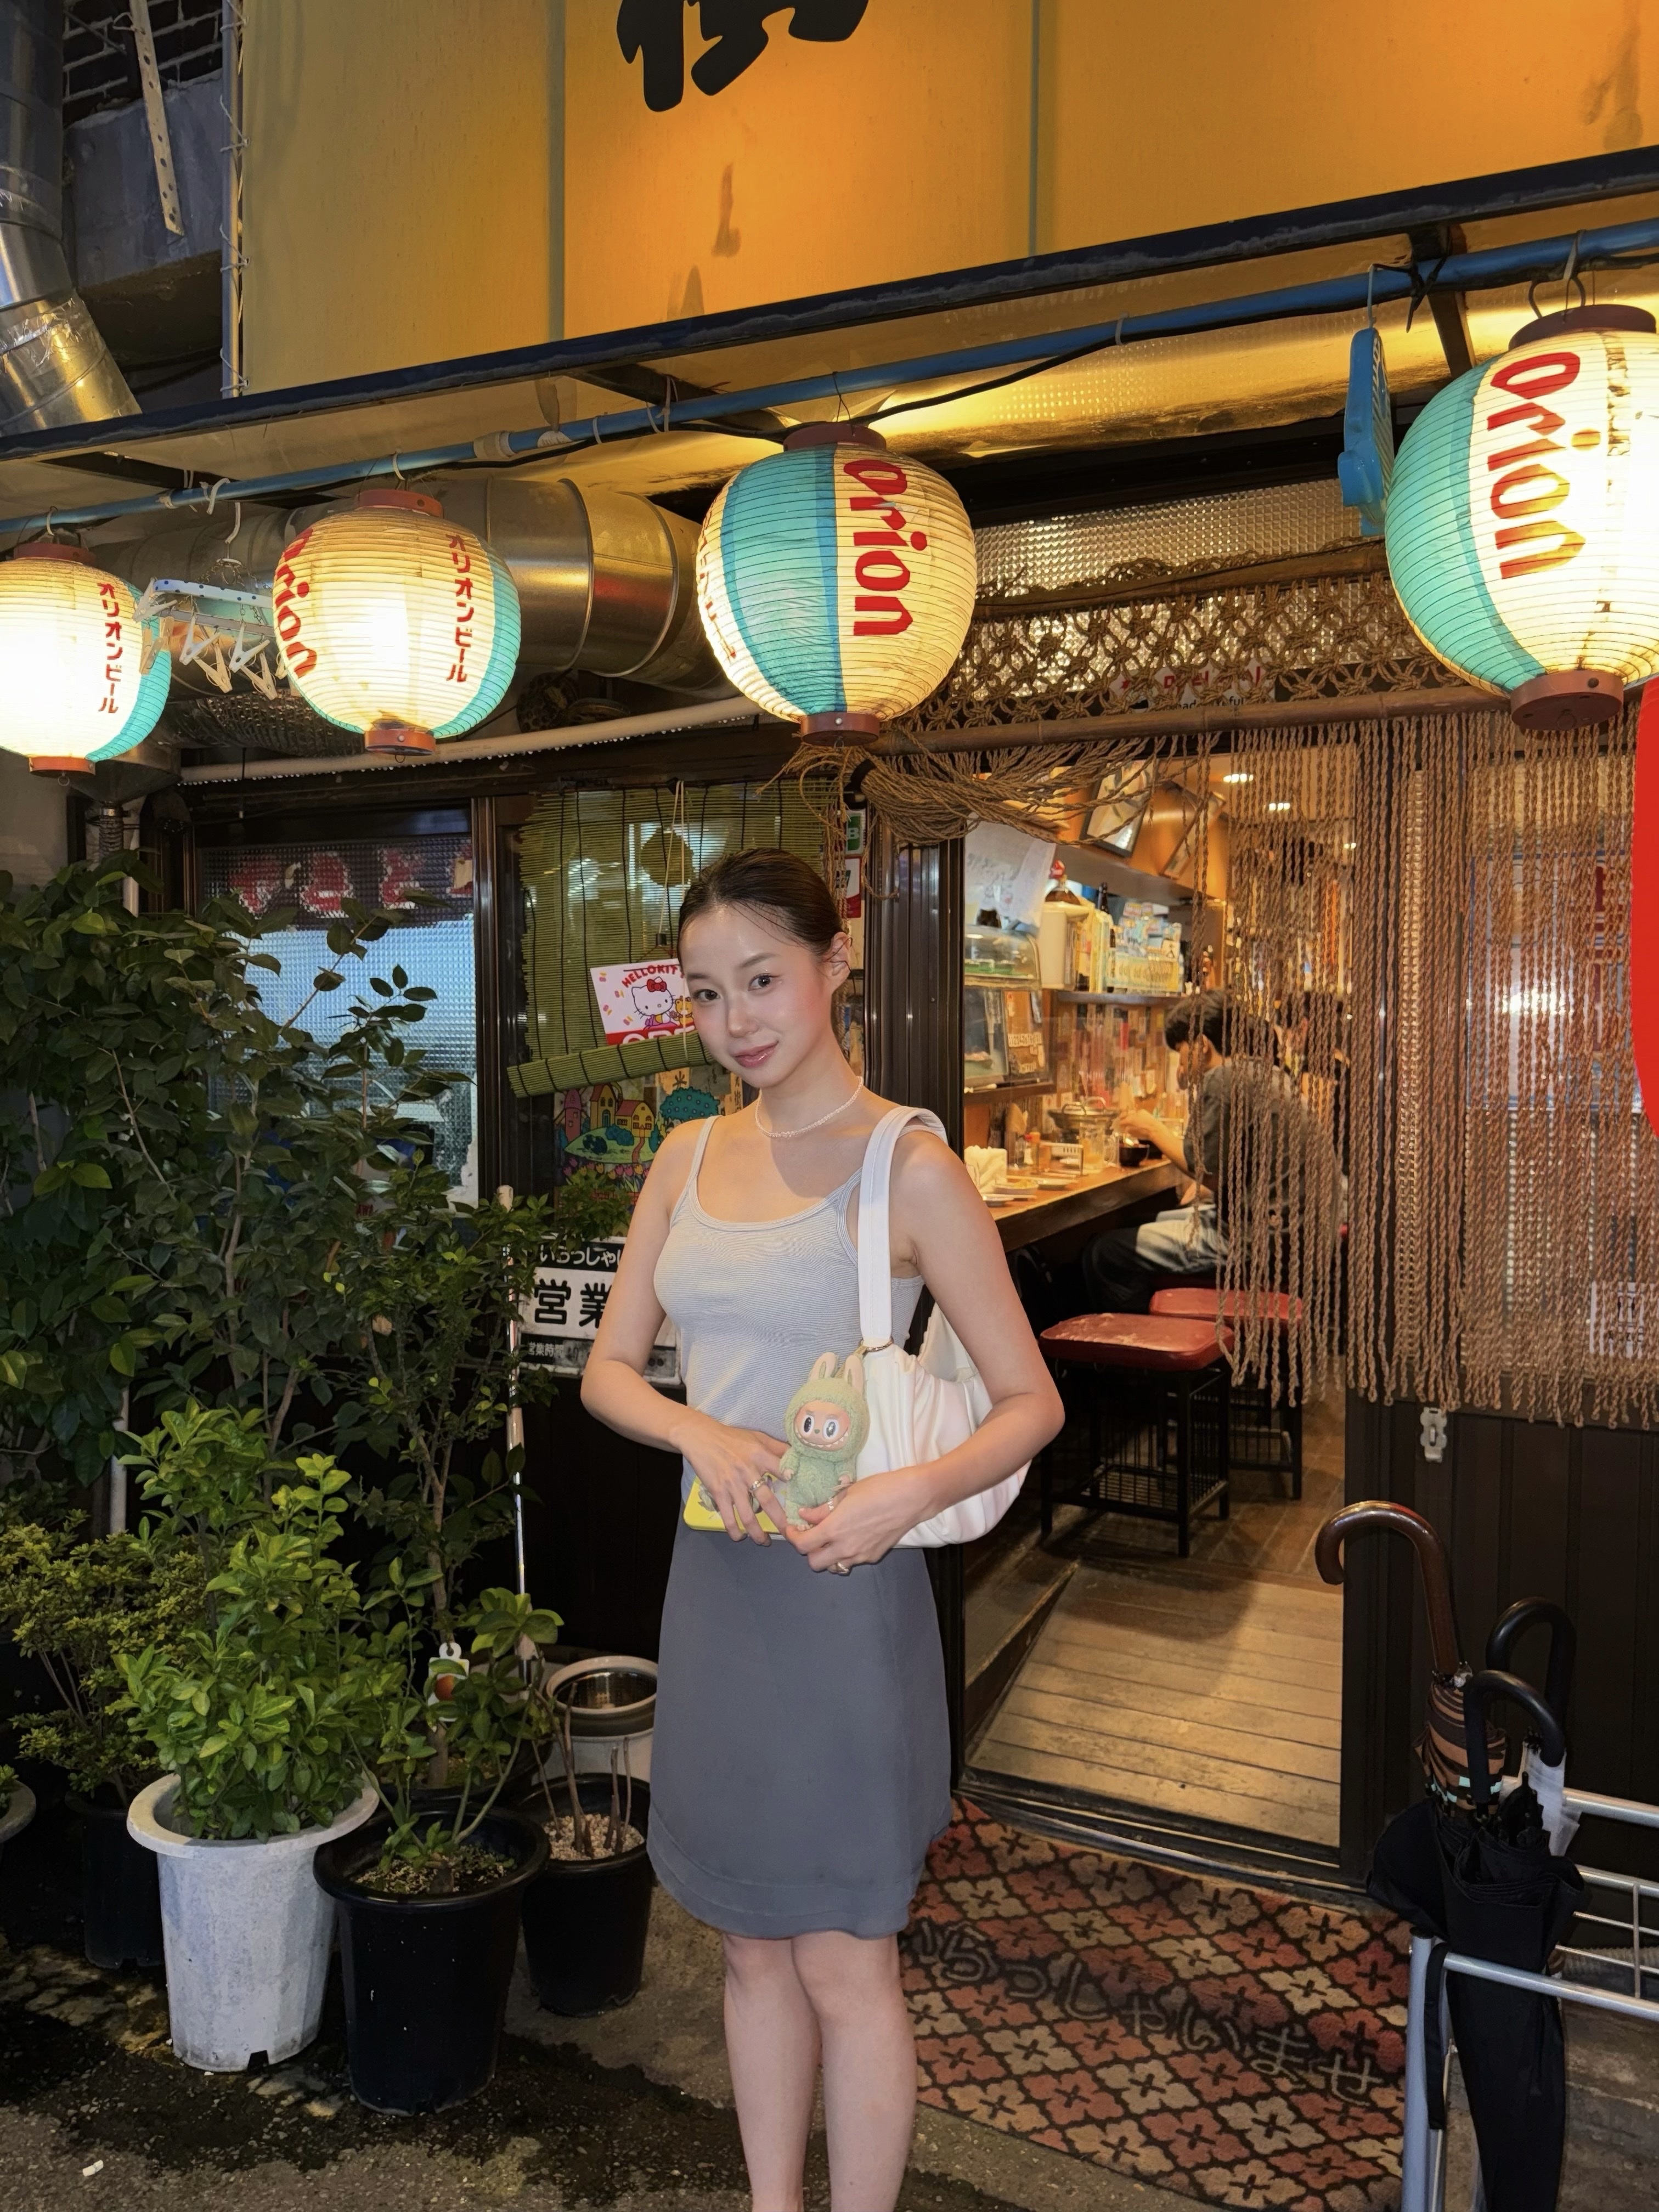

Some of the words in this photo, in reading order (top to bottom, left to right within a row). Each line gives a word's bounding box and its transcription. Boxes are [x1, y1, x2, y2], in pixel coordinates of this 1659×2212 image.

[97, 583, 123, 714] オリオンビール
[445, 534, 475, 682] オリオンビール
